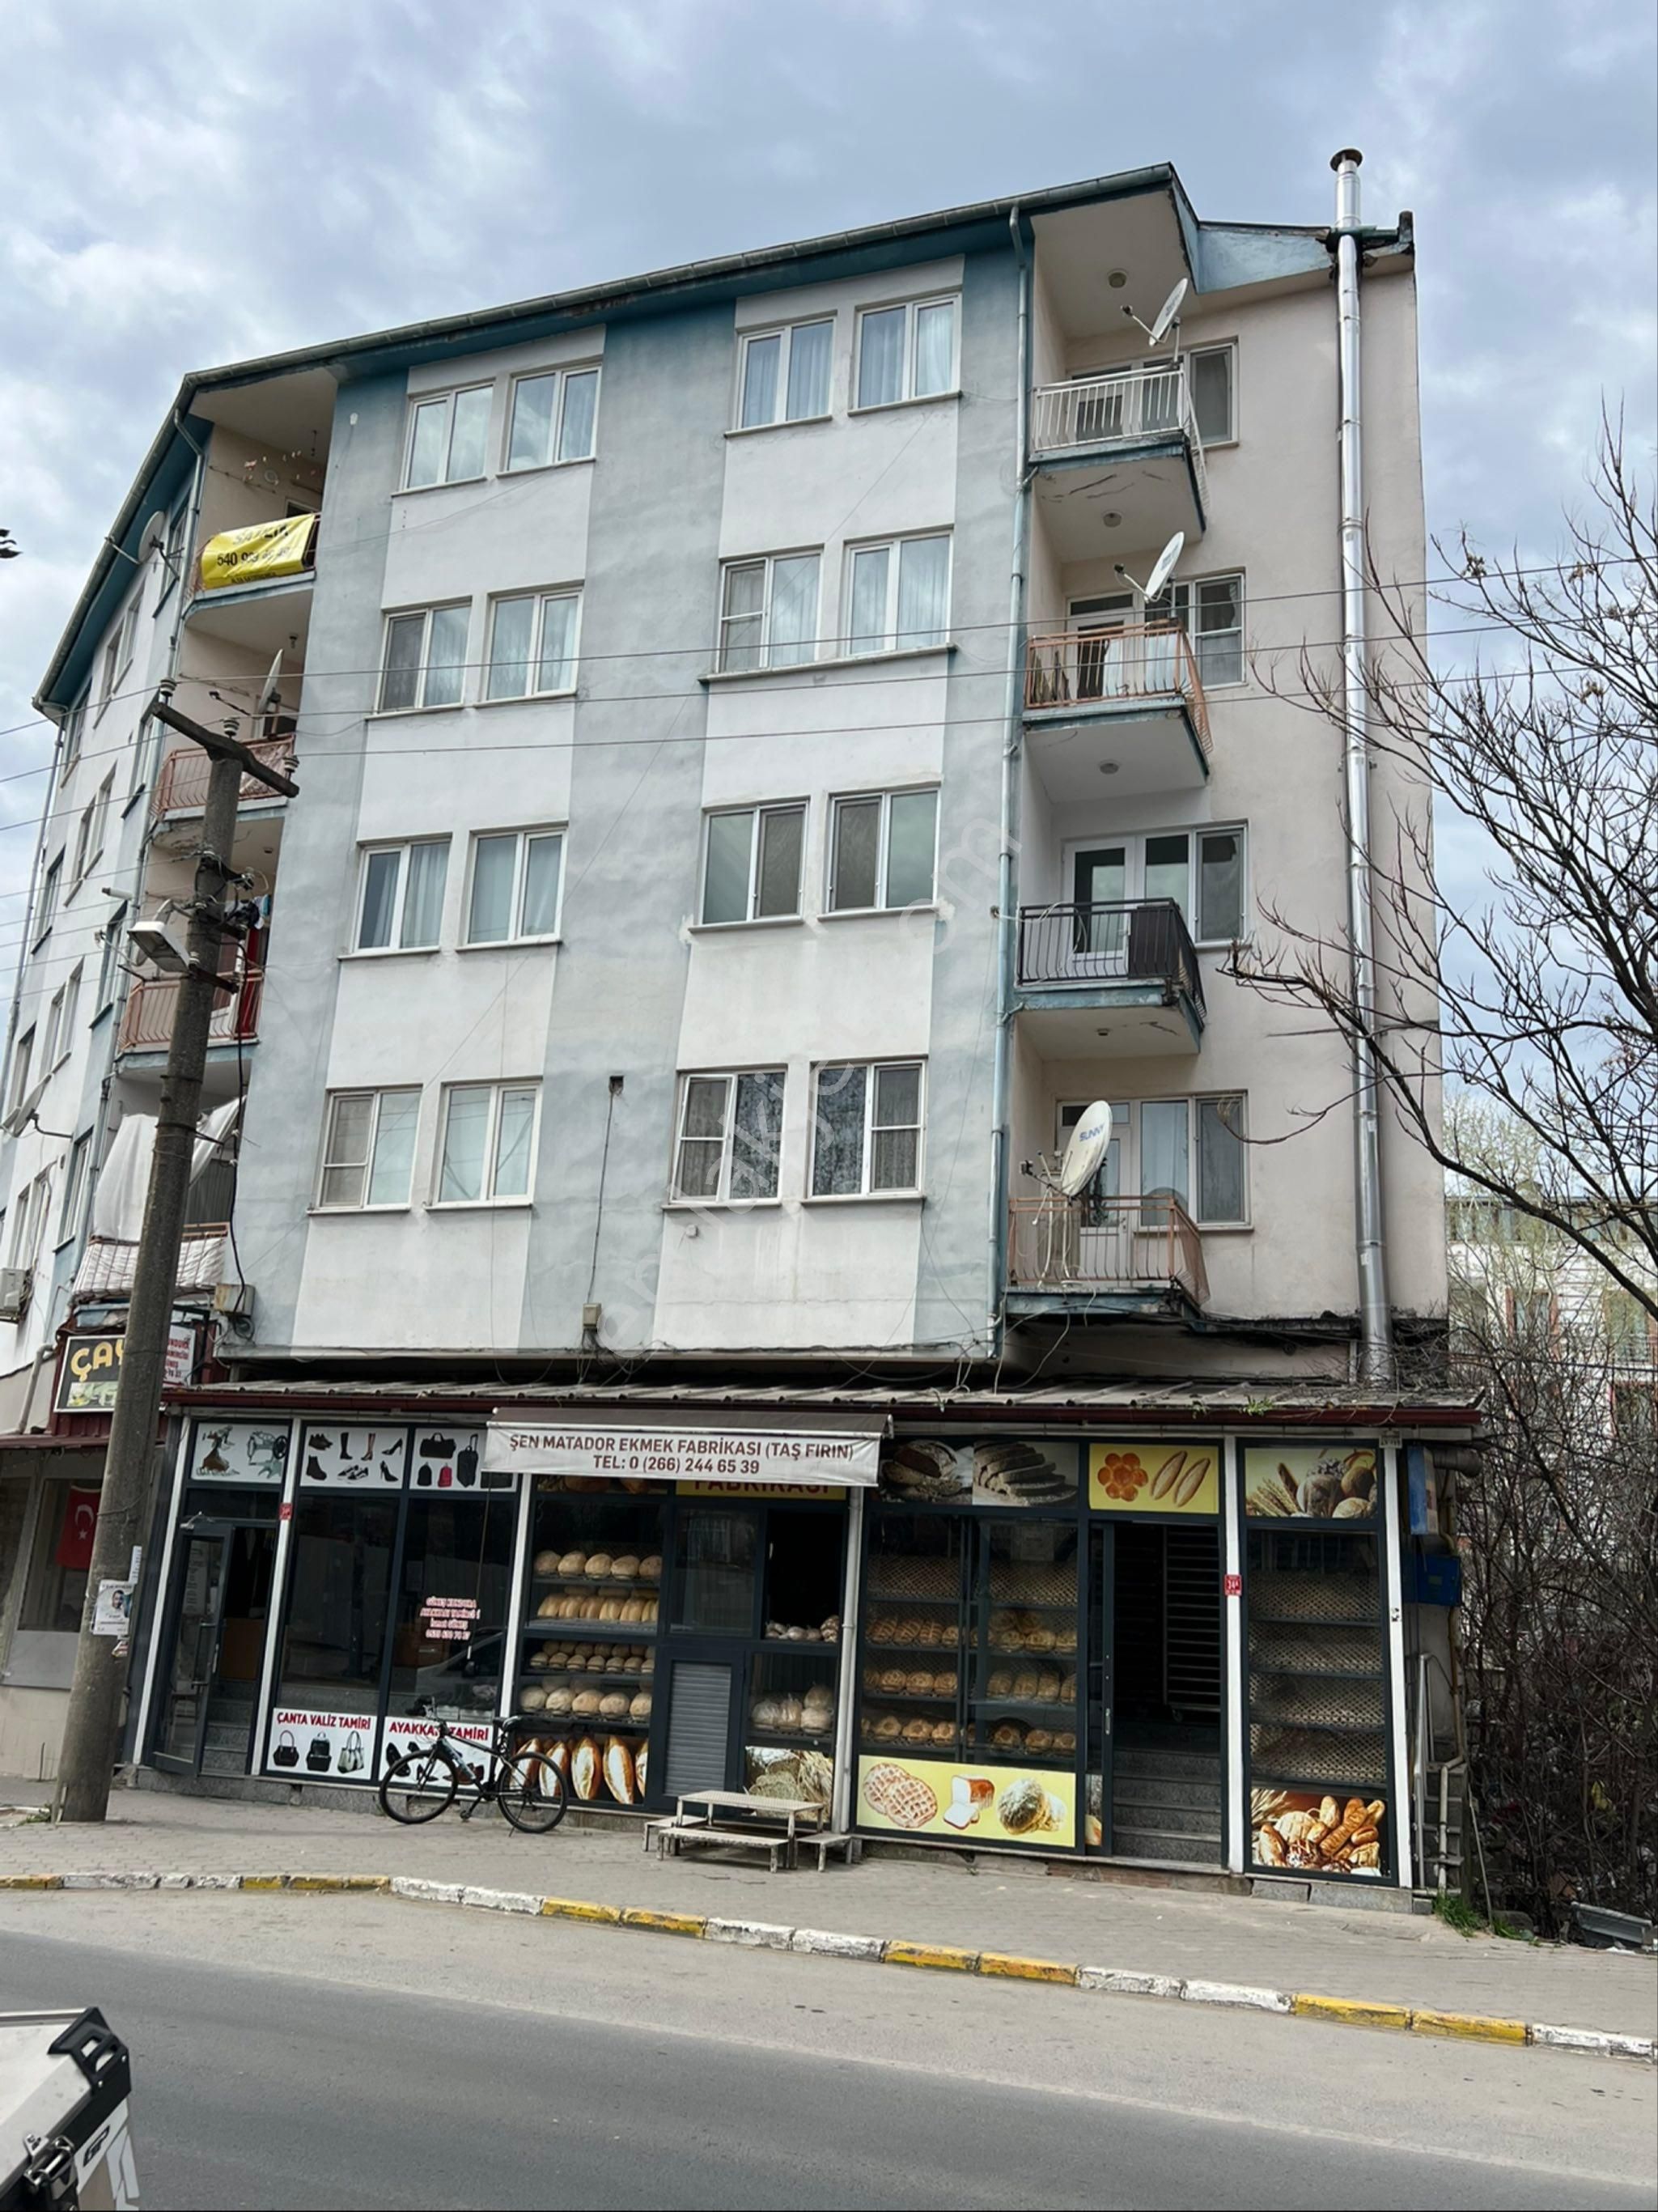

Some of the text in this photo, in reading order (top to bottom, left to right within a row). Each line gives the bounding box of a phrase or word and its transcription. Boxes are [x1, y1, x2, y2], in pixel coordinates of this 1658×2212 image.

[510, 1434, 854, 1461] ŞEN MATADOR EKMEK FABRİKASI (TAŞ FIRIN)
[593, 1455, 760, 1474] TEL: 0 (266) 244 65 39
[277, 1712, 371, 1730] ÇANTA VALİZ TAMİRİ
[389, 1722, 441, 1737] AYAKKA
